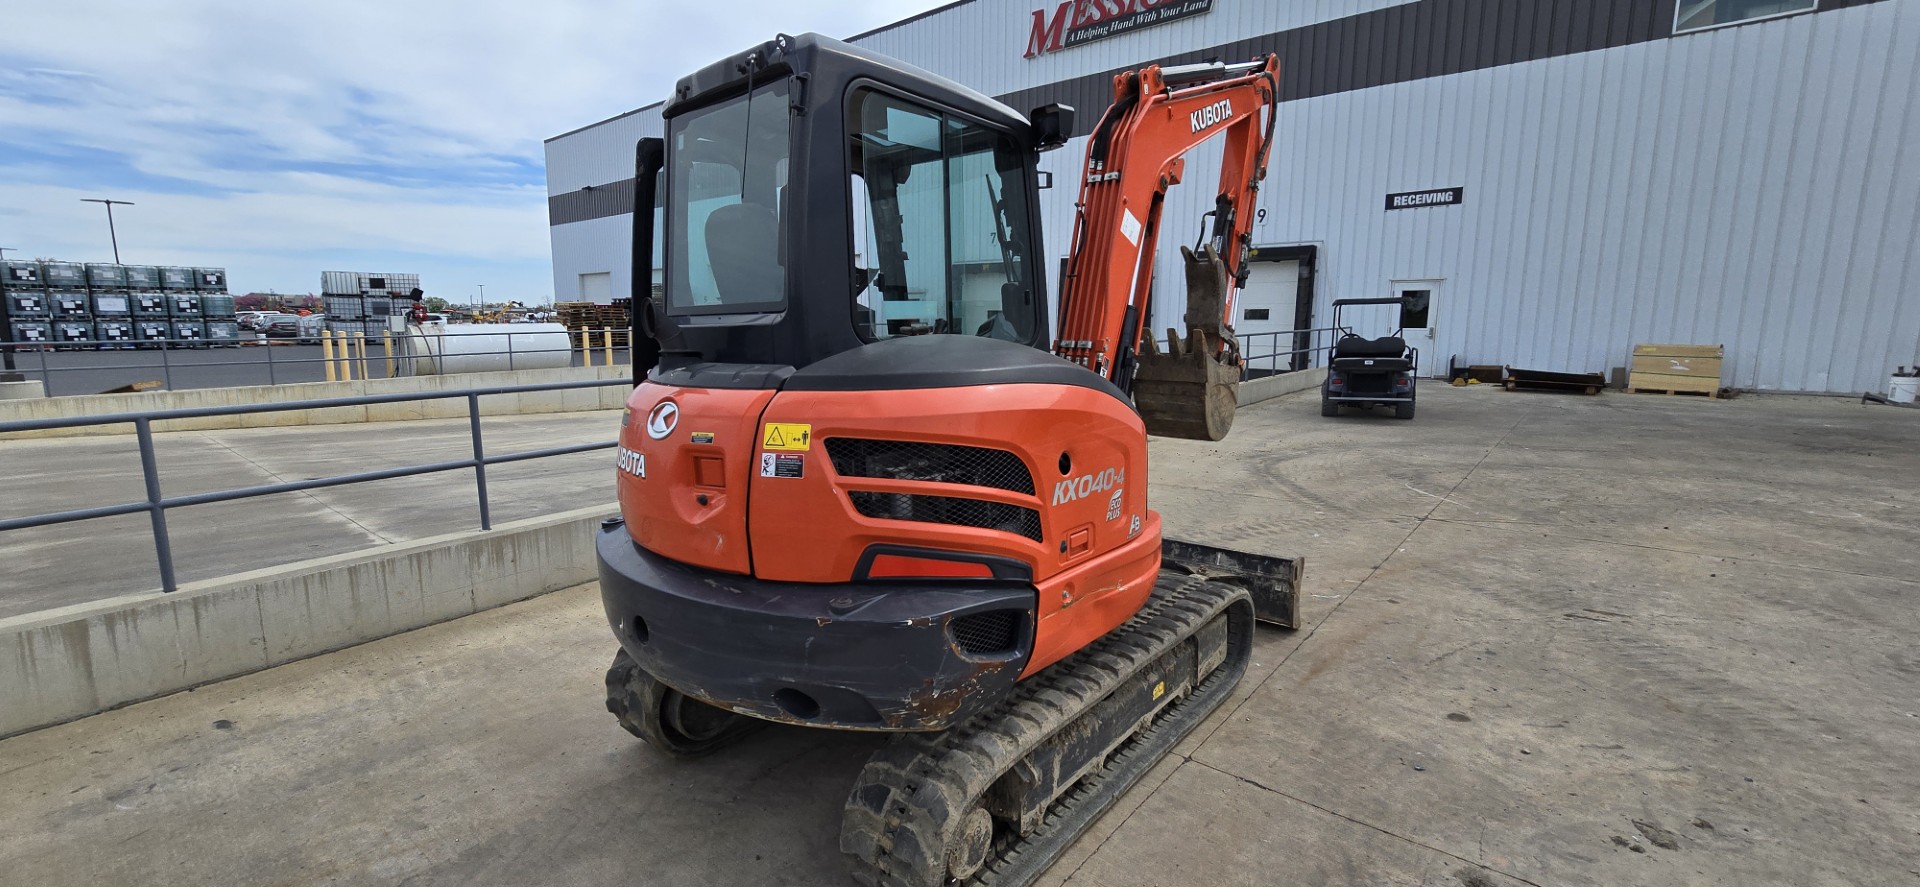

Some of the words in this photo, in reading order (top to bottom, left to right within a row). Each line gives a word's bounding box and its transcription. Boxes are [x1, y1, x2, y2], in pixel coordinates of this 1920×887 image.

[1068, 32, 1074, 43] A
[1077, 26, 1109, 39] Helping
[1110, 16, 1134, 32] Hand
[1136, 11, 1157, 25] With
[1160, 7, 1181, 18] Your
[1183, 0, 1208, 12] Land
[1190, 99, 1233, 134] KUBOTA
[1393, 191, 1454, 206] RECEIVING
[1257, 208, 1266, 223] 9
[990, 232, 996, 244] 7
[617, 447, 646, 478] UBOTA
[1052, 467, 1124, 506] KX040-4
[1106, 508, 1121, 522] PLUS
